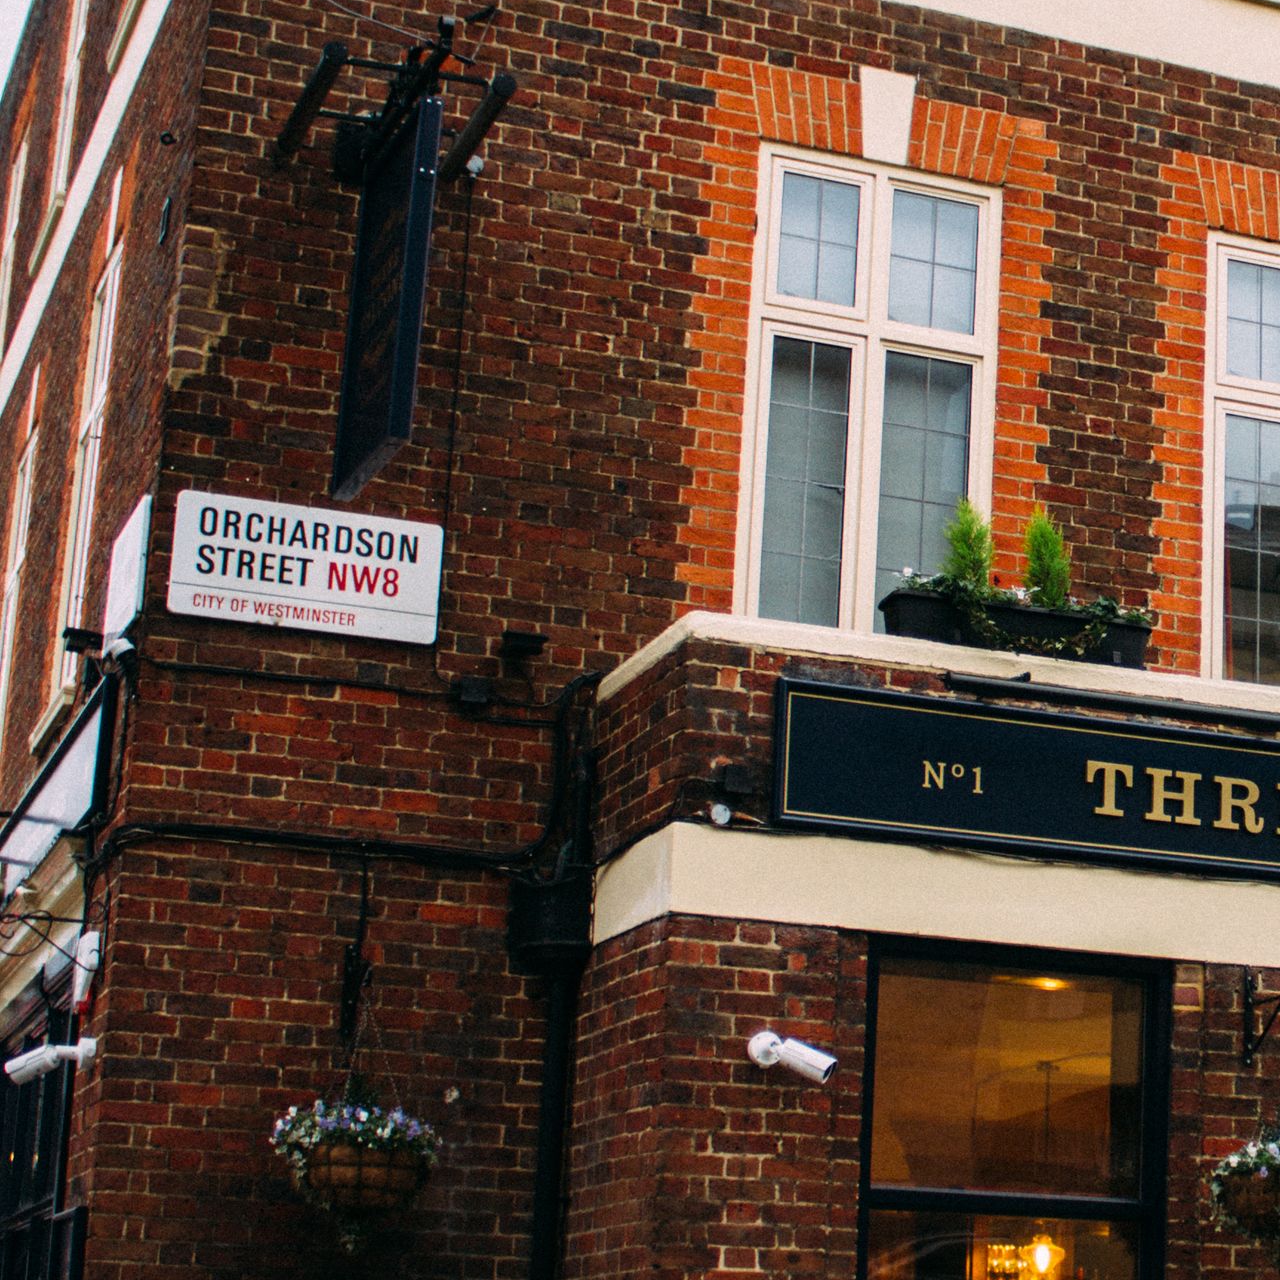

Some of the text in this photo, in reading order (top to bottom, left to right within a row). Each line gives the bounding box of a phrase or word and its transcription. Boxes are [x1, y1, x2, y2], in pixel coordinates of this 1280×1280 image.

[199, 506, 419, 564] ORCHARDSON
[196, 544, 400, 598] STREET NW8
[192, 593, 356, 628] CITY OF WESTMINSTER
